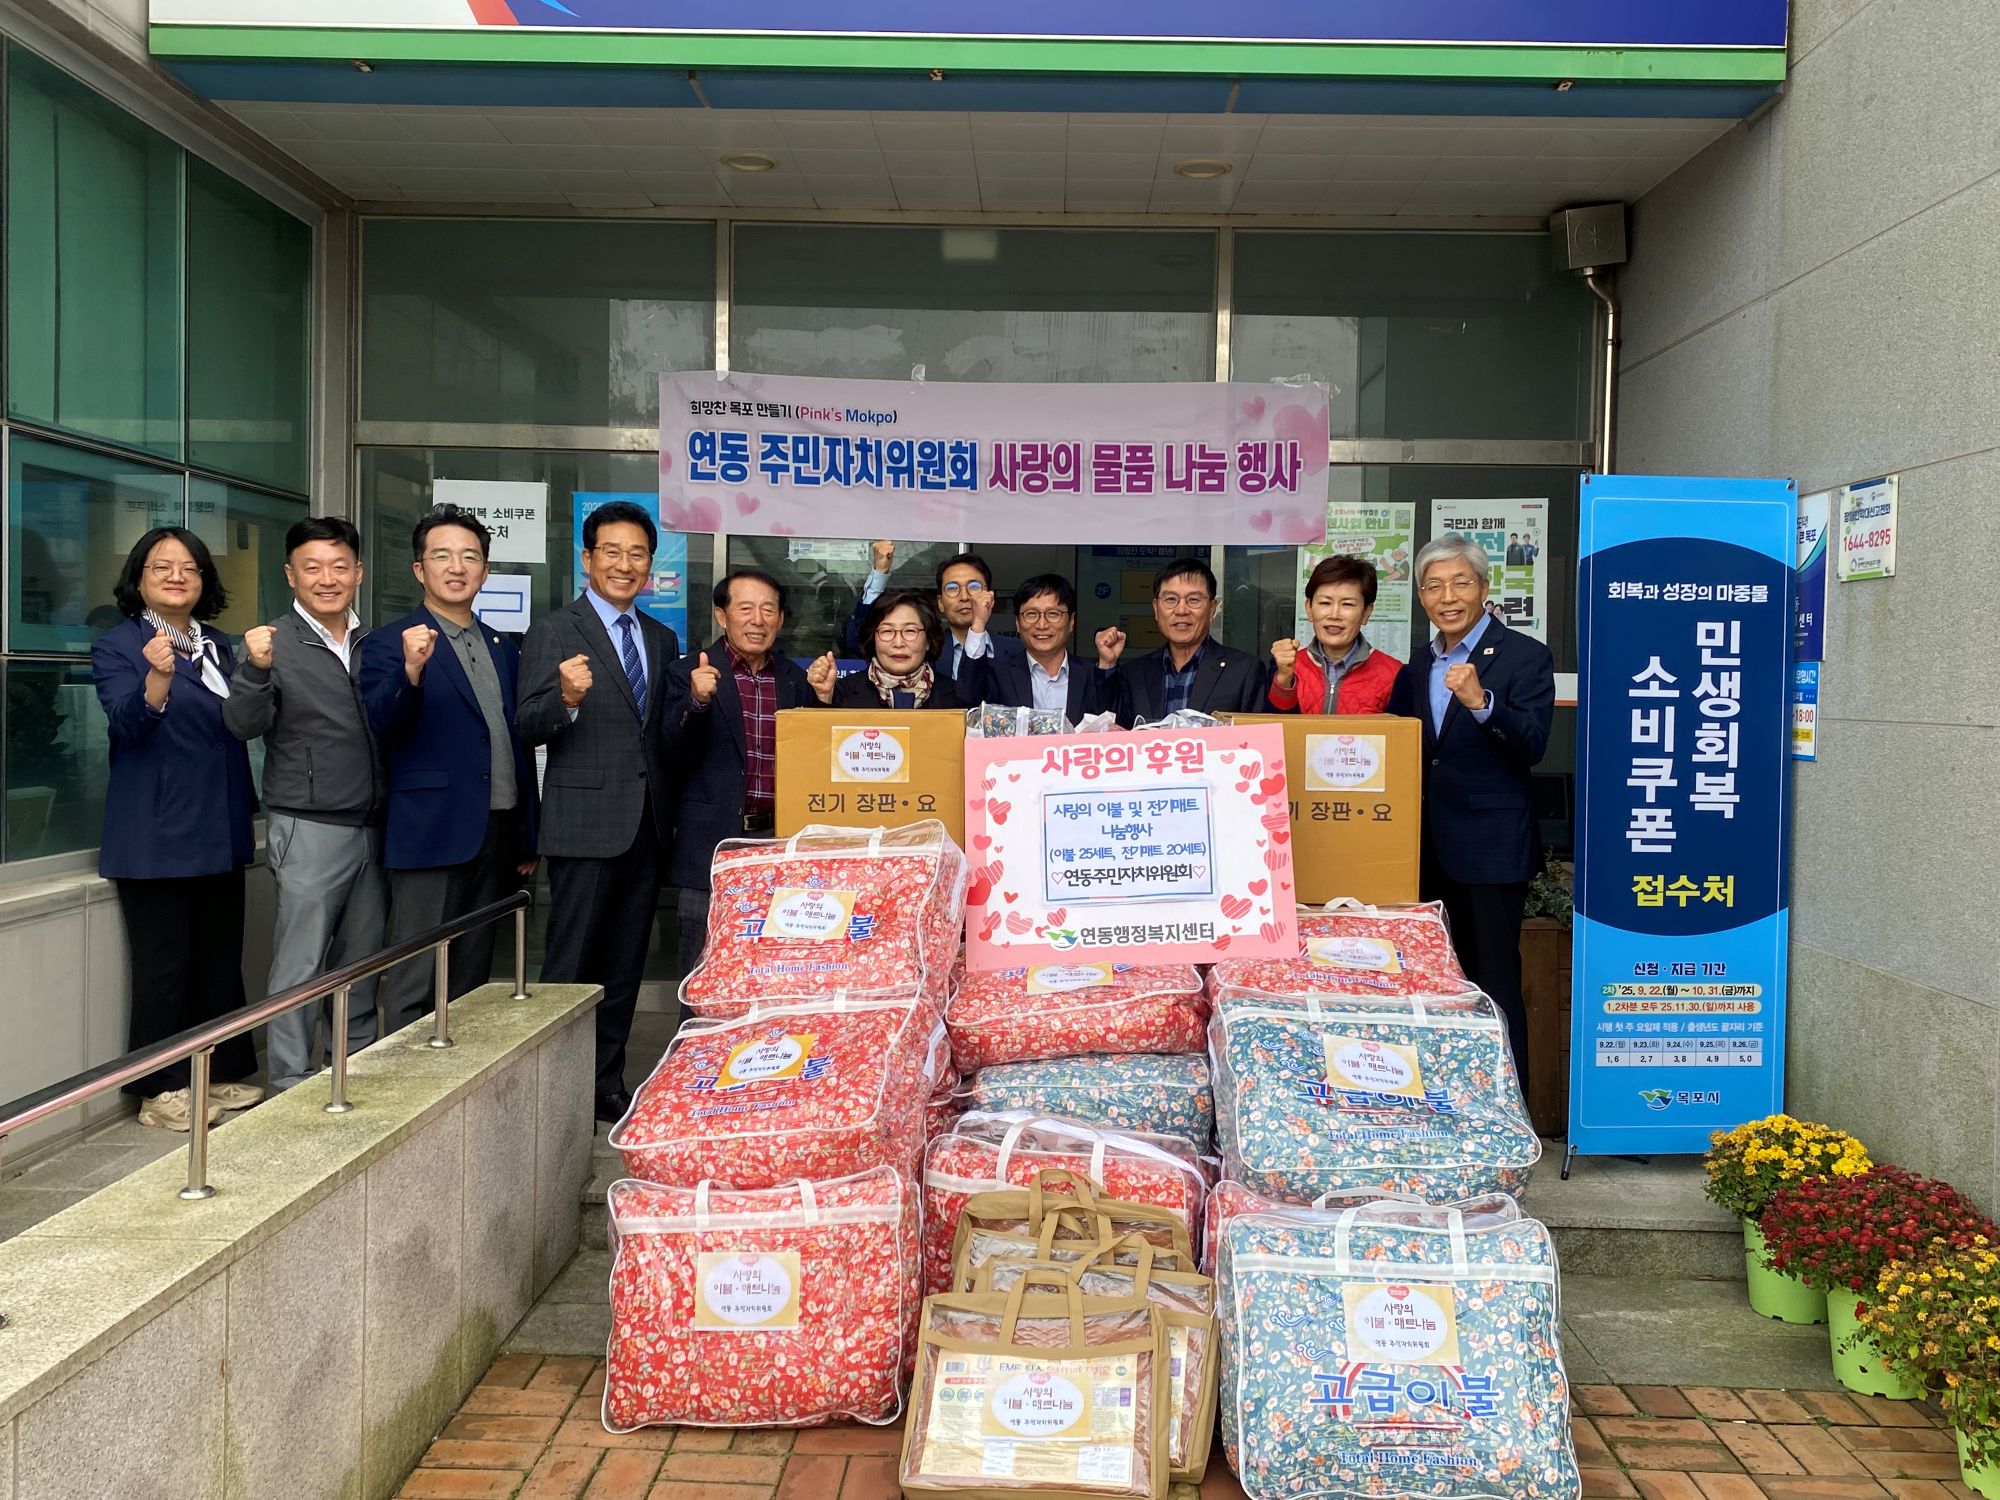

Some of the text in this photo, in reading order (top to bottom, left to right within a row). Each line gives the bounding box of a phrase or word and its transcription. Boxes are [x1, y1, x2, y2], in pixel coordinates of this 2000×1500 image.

[690, 400, 897, 426] 희망찬 목포 만들기 (Pink's Mokpo)
[689, 431, 1302, 492] 연동 주민자치위원회 사랑의 물품 나눔 행사
[457, 507, 535, 520] 생회복 소비쿠폰
[1443, 518, 1505, 529] 국민과 함께
[485, 525, 509, 539] 수처
[1844, 528, 1891, 552] 1644-8295
[1096, 587, 1110, 597] 2F
[1608, 582, 1768, 603] 회복과 성장의 마중물
[1689, 620, 1741, 819] 민생회복
[1041, 742, 1204, 779] 사랑의 후원
[1626, 656, 1680, 853] 소비쿠폰
[807, 793, 936, 813] 전기 장판 요
[1053, 798, 1200, 820] 사랑의 이불 및 전기매트
[1288, 801, 1392, 821] 기 장판 요
[1101, 823, 1153, 840] 나눔행사
[1049, 842, 1206, 863] (이불 25세트, 전기매트 20세트)
[1064, 864, 1193, 887] 연동주민자치위원회
[1631, 875, 1735, 907] 접수처
[1081, 921, 1215, 946] 연동행정복지센터
[777, 963, 805, 973] Home
[809, 962, 849, 973] Fashion
[1634, 963, 1726, 976] 신청 지급 기간
[1641, 1003, 1658, 1012] 모두
[1737, 1003, 1755, 1012] 사용
[1362, 1129, 1397, 1140] Home
[1401, 1128, 1449, 1139] Fashion
[1384, 1303, 1414, 1316] 사랑의
[1395, 1317, 1436, 1331] 매트나눔
[1023, 1387, 1052, 1398] 사랑의
[1310, 1370, 1500, 1418] 고급이불
[1341, 1452, 1478, 1467] Total Home Fashion
